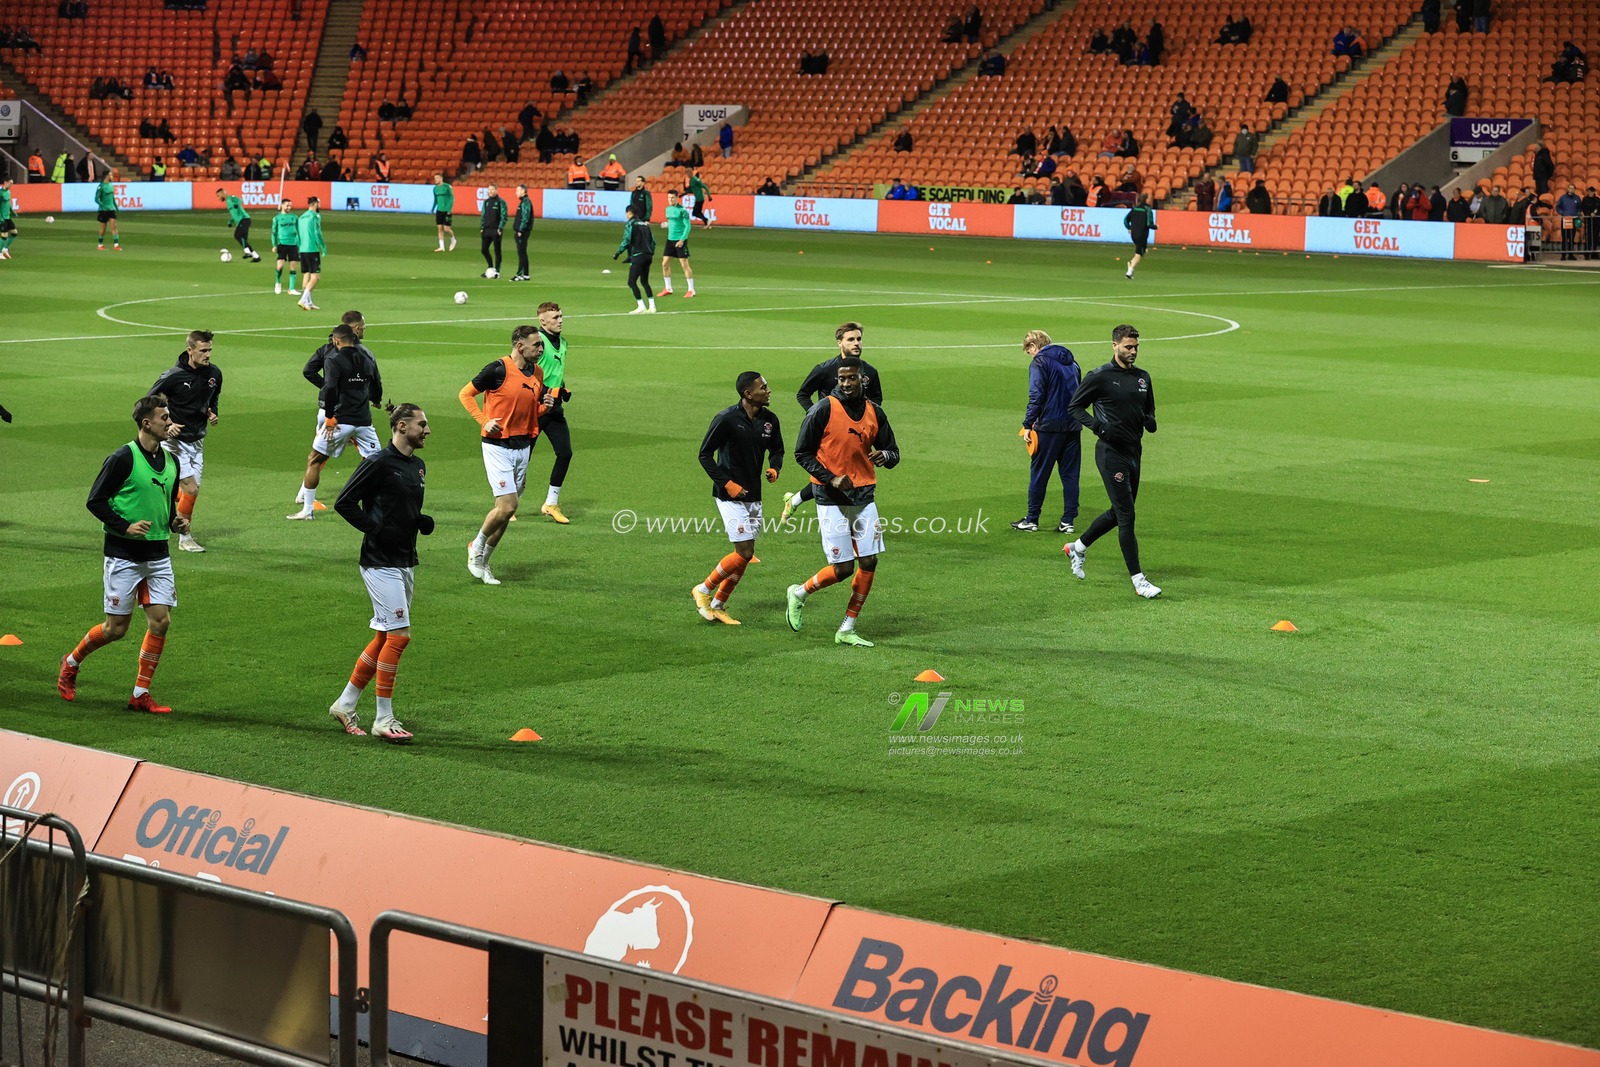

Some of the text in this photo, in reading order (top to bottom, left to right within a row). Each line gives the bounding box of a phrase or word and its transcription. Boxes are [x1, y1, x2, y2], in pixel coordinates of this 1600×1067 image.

[698, 107, 727, 121] yayzi
[1471, 121, 1511, 138] yayzi
[1451, 151, 1458, 160] 6
[113, 184, 127, 195] ET
[241, 181, 265, 193] GET
[371, 185, 389, 196] GET
[476, 187, 489, 199] GE
[114, 196, 143, 208] OCAL
[371, 197, 401, 209] VOCAL
[577, 191, 595, 203] GET
[682, 195, 696, 207] GE
[929, 188, 1005, 204] SCAFFOLDING
[577, 204, 609, 217] VOCAL
[794, 199, 816, 212] GET
[928, 203, 952, 217] GET
[794, 213, 830, 226] VOCAL
[1061, 208, 1085, 222] GET
[1208, 213, 1235, 228] GET
[928, 217, 967, 231] VOCAL
[1061, 223, 1101, 237] VOCAL
[1354, 220, 1381, 234] GET
[1208, 228, 1252, 244] VOCAL
[1353, 235, 1400, 251] VOCAL
[136, 798, 290, 875] Official
[832, 936, 1151, 1067] Backing
[565, 973, 951, 1067] PLEASE REM
[559, 1025, 676, 1067] WHILST
